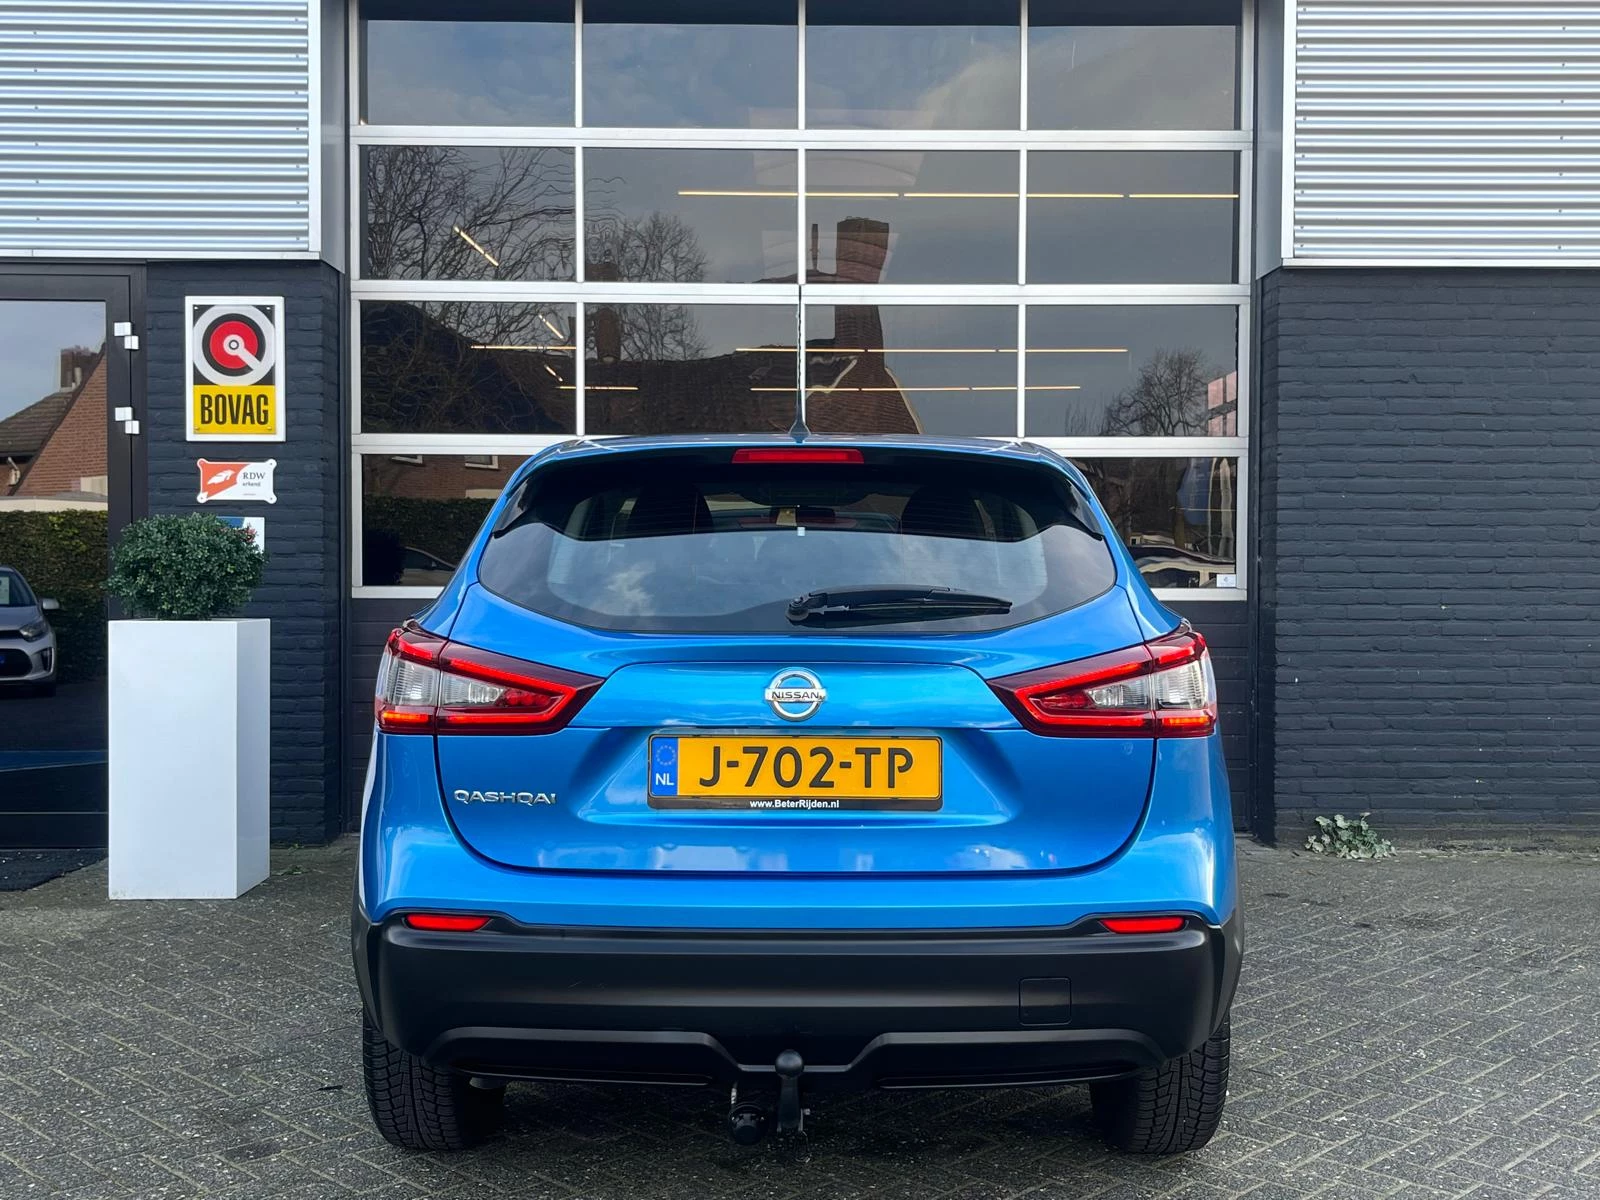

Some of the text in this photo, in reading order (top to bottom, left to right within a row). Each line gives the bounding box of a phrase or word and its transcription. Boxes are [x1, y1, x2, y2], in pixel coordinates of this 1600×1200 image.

[200, 394, 269, 425] BOVAG
[242, 472, 265, 480] RDW
[771, 691, 819, 699] NISSAN
[699, 746, 914, 788] J-702-TP
[655, 773, 674, 786] NL
[454, 789, 556, 806] QASHQAI
[750, 799, 840, 809] www.BeterRijden.nl
